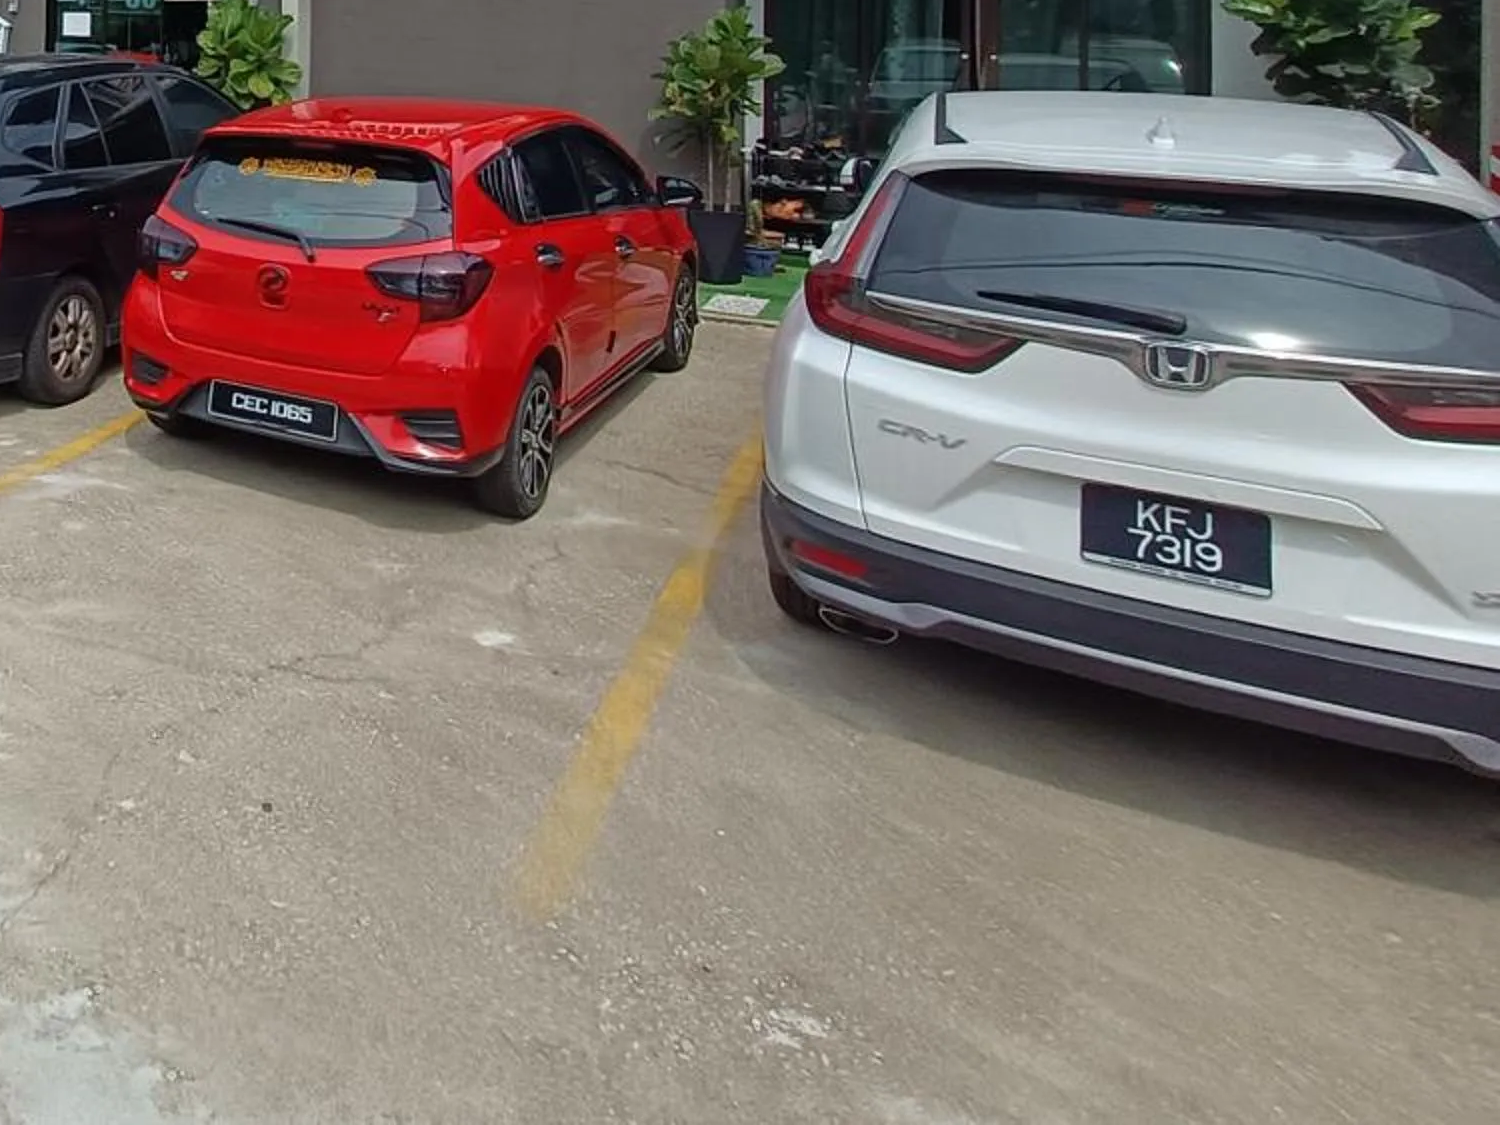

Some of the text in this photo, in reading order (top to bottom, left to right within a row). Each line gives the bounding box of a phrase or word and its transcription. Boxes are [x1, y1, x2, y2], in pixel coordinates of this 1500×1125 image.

[231, 391, 313, 424] CEC 1065
[1136, 499, 1213, 541] KFJ
[1126, 527, 1223, 573] 7319
